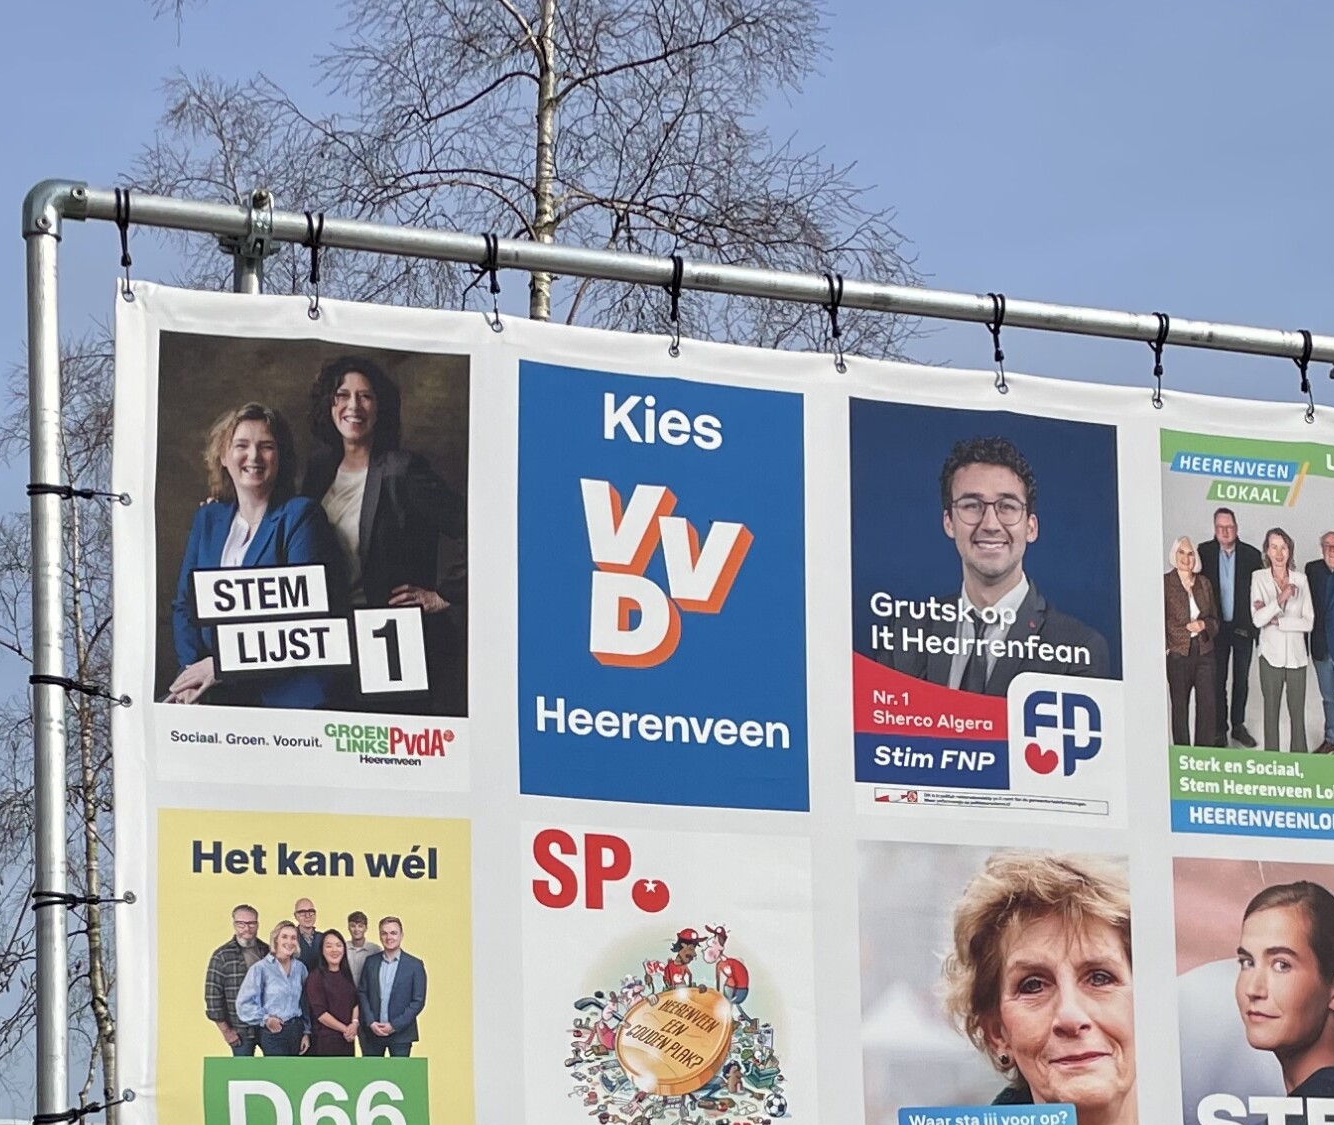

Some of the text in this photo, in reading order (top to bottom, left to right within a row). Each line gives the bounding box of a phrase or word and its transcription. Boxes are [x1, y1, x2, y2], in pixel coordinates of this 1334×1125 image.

[603, 392, 722, 451] Kies
[1179, 454, 1288, 479] HEERENVEEN
[1217, 483, 1281, 503] LOKAAL
[214, 575, 308, 612] STEM
[870, 592, 1016, 630] Grutsk op
[237, 626, 330, 665] LIJST
[372, 618, 402, 682] 1
[871, 626, 1091, 665] It Hearrenfean
[873, 690, 910, 706] Nr. 1
[324, 723, 388, 741] GROEN
[536, 696, 791, 749] Heerenveen
[873, 708, 993, 732] Sherco Algera
[170, 730, 323, 748] Sociaal. Groen. Vooruit.
[335, 738, 388, 755] LINKS
[390, 727, 445, 756] PvdA
[359, 754, 421, 766] Heerenveen
[874, 747, 995, 771] Stim FNP
[1179, 755, 1304, 778] Sterk en Sociaal,
[1179, 777, 1220, 795] Stem
[1223, 778, 1312, 799] Heerenveen
[191, 840, 438, 880] Het kan wél
[658, 999, 720, 1033] HEERENVEEN
[660, 1019, 687, 1036] EEN
